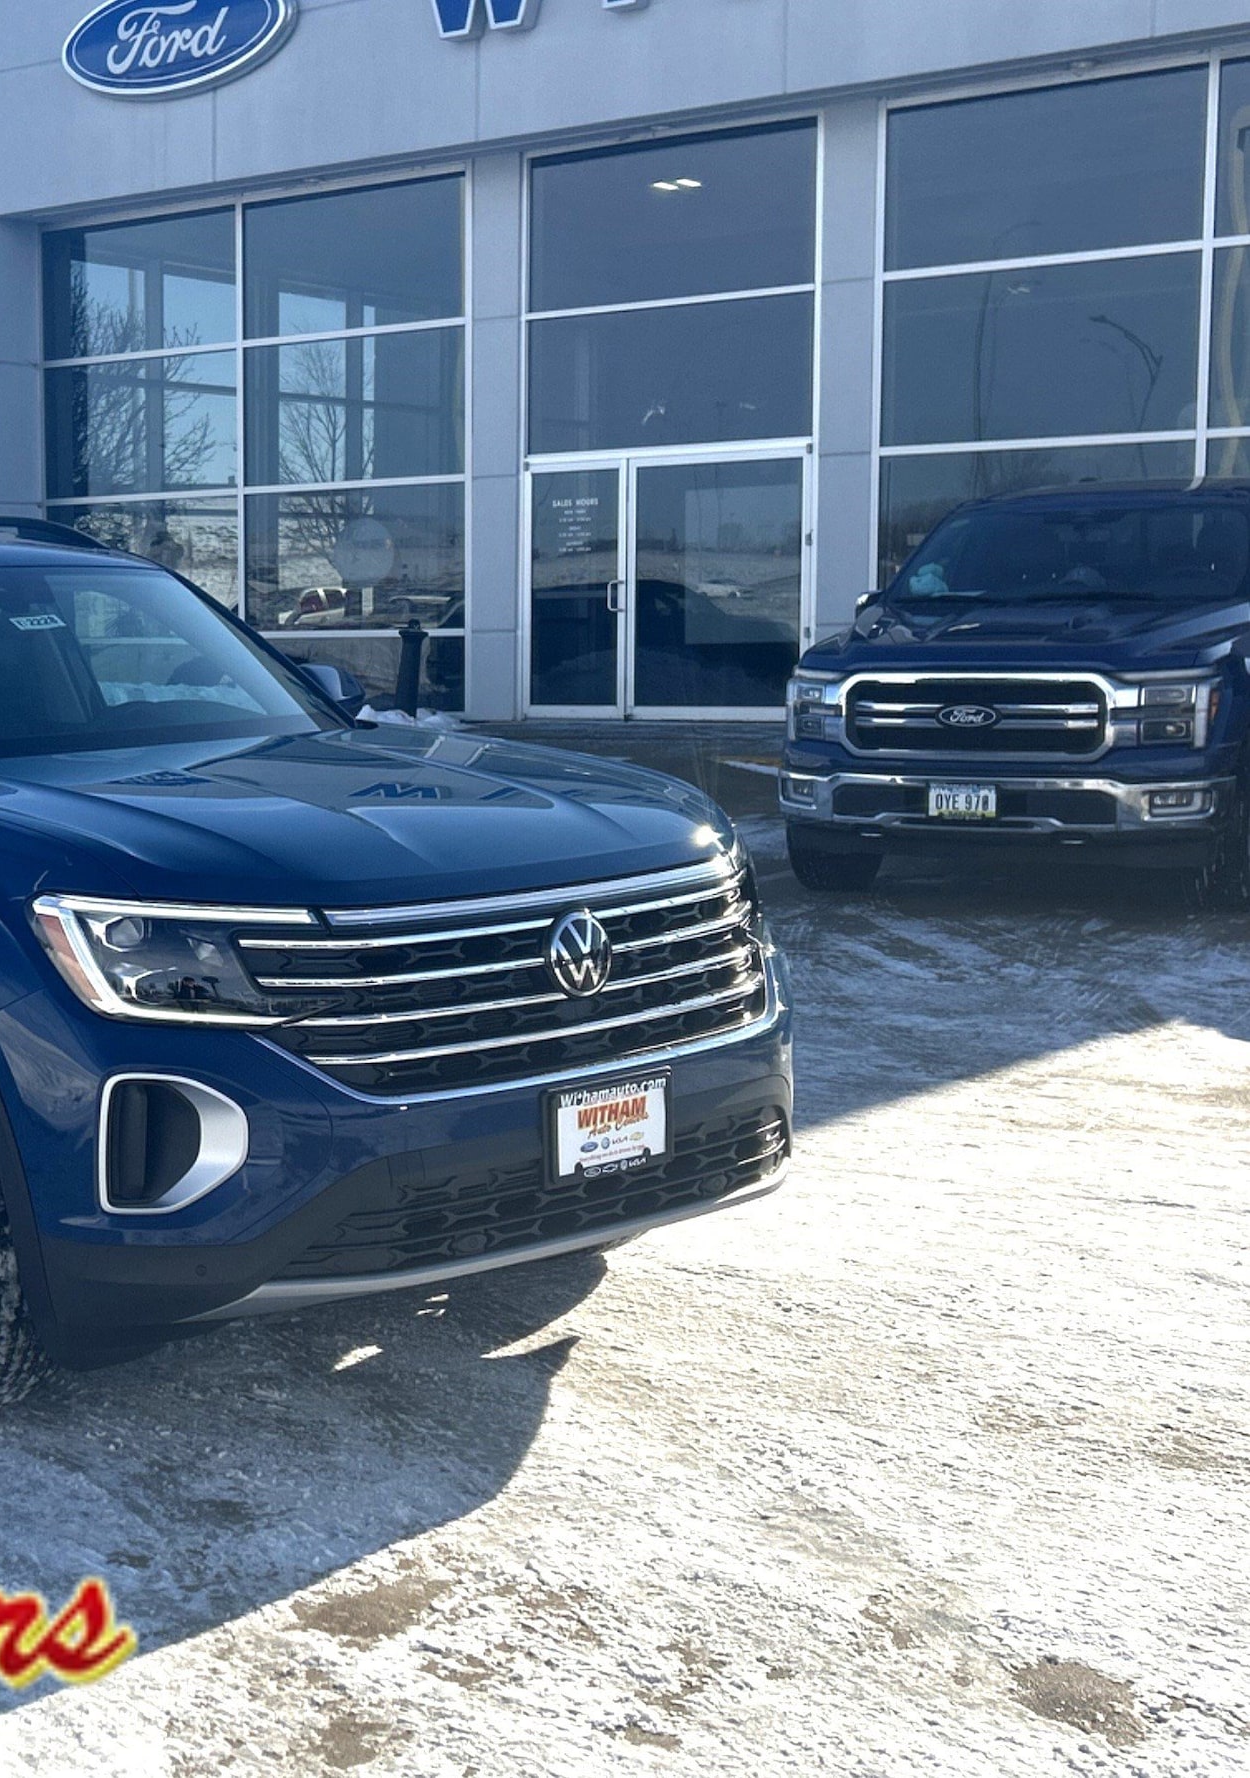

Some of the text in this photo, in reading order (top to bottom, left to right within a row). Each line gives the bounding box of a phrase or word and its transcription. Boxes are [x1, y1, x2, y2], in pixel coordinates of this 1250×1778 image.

[106, 0, 230, 75] Ford
[950, 708, 985, 723] Ford
[577, 1095, 647, 1130] WITHAM
